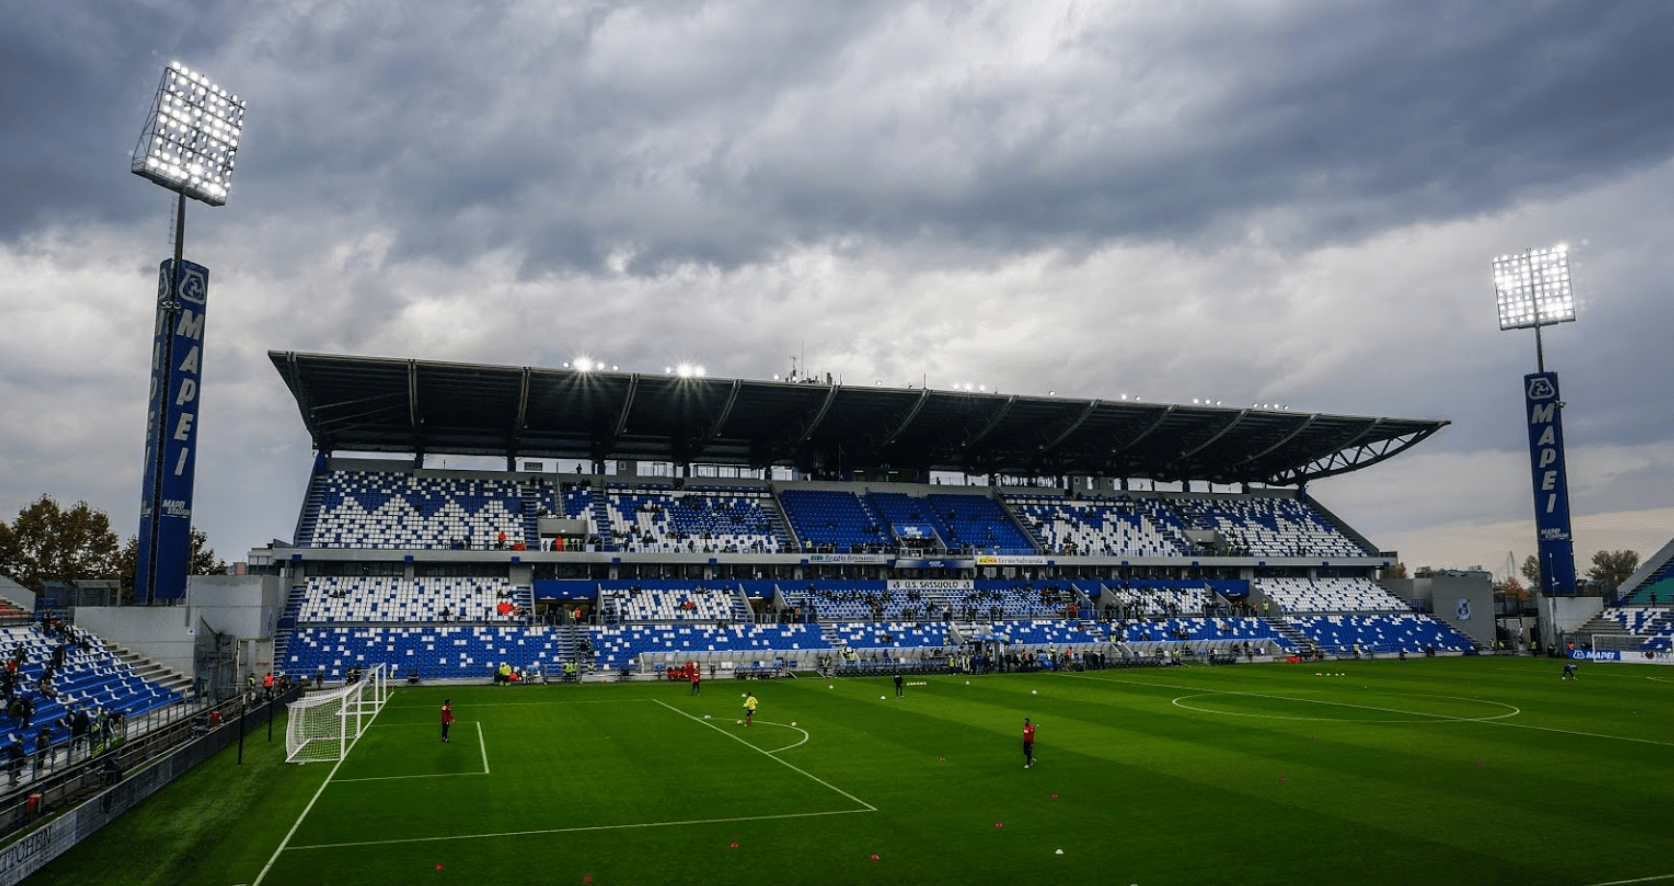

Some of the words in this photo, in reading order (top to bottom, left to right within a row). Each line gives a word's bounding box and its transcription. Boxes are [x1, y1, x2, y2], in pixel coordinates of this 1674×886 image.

[174, 309, 205, 476] MAPEI
[1531, 402, 1557, 513] MAPEI
[162, 499, 185, 509] MAPEI
[1585, 651, 1616, 659] MAPEI
[0, 826, 53, 873] ITCHEN
